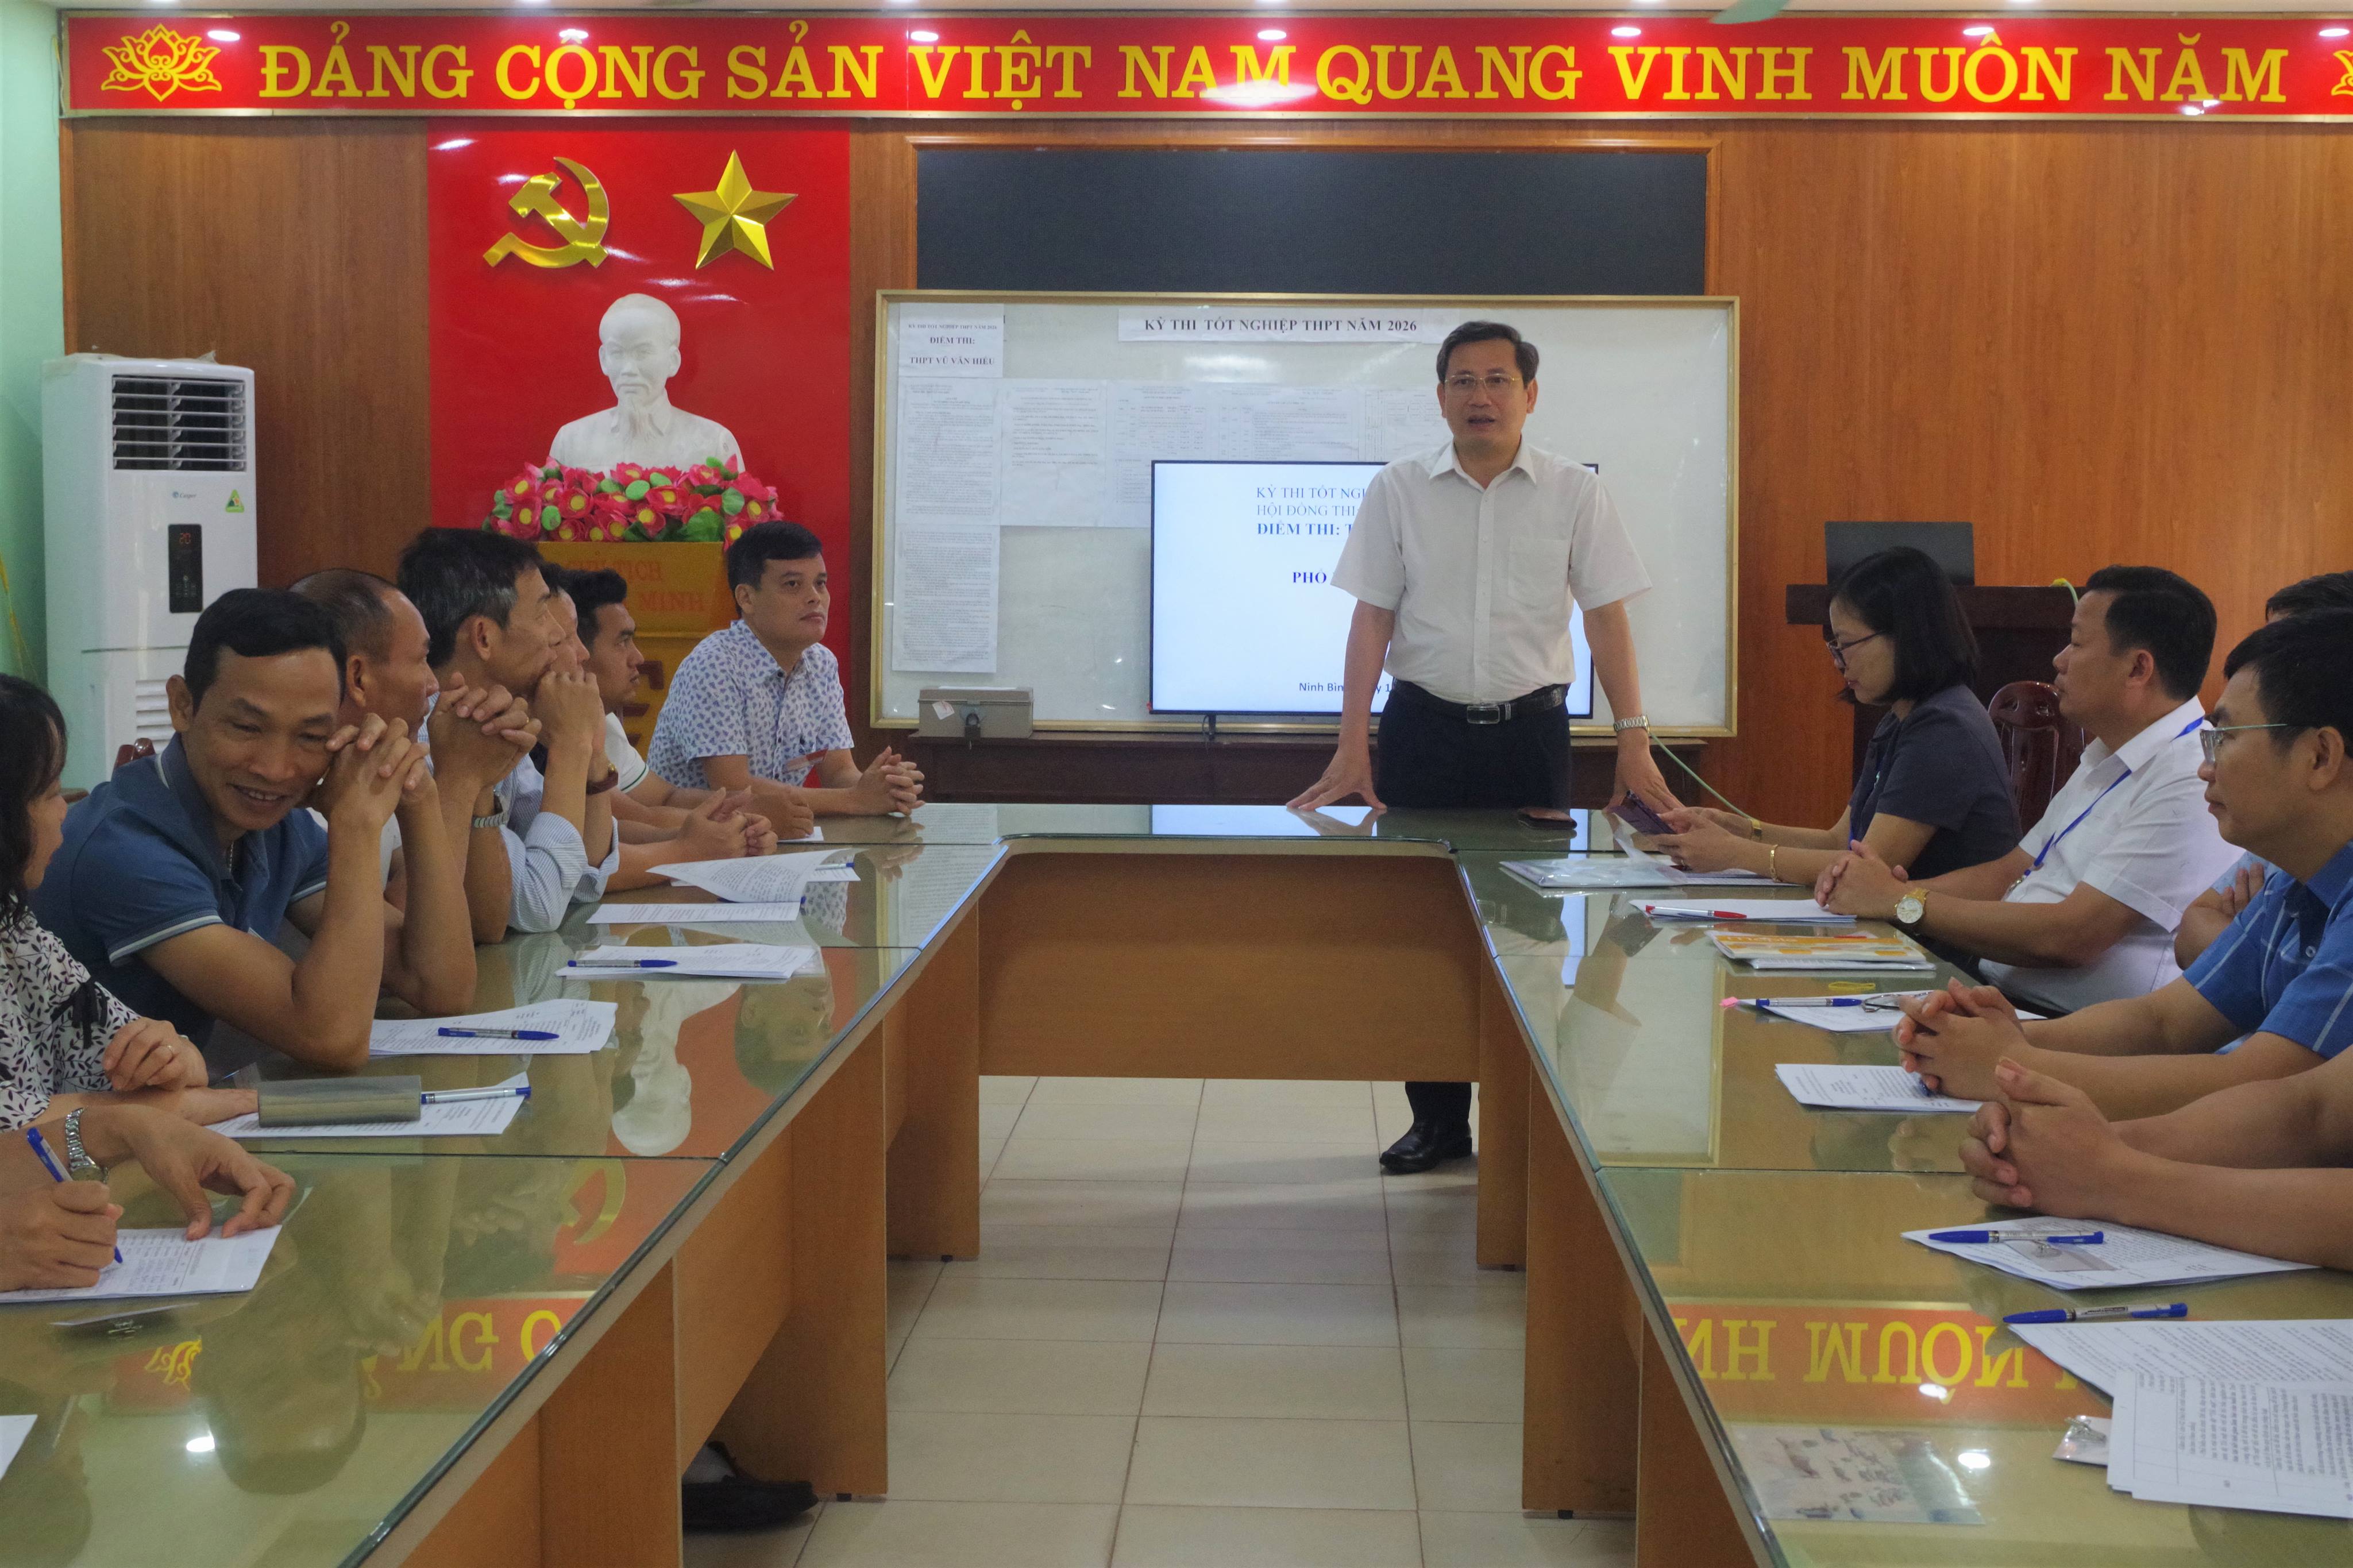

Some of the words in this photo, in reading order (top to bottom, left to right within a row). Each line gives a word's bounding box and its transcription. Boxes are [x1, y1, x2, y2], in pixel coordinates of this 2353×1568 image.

[260, 21, 473, 100] ĐẢNG
[495, 36, 705, 110] CỘNG
[727, 20, 884, 99] SẢN
[908, 29, 1092, 110] VIỆT
[1118, 45, 1296, 99] NAM
[1316, 45, 1583, 105] QUANG
[1608, 46, 1813, 101] VINH
[1841, 31, 2078, 103] MUÔN
[2104, 32, 2289, 103] NĂM
[1145, 316, 1166, 330] KỲ
[1170, 319, 1196, 330] THI
[1204, 316, 1235, 331] TỐT
[1240, 318, 1297, 333] NGHIỆP
[1302, 320, 1343, 331] THPT
[1347, 318, 1381, 331] NĂM
[1387, 320, 1417, 331] 2026
[956, 337, 975, 345] THI:
[910, 357, 934, 365] THPT
[1257, 484, 1276, 498] KỲ
[1281, 488, 1304, 499] THI
[1309, 485, 1337, 499] TỐT
[1257, 502, 1282, 518] HỘI
[1287, 501, 1328, 516] ĐỒNG
[1257, 520, 1300, 535] ĐIỂM
[1305, 523, 1340, 535] THI:
[1299, 682, 1324, 692] Ninh
[1327, 682, 1344, 692] Bìn
